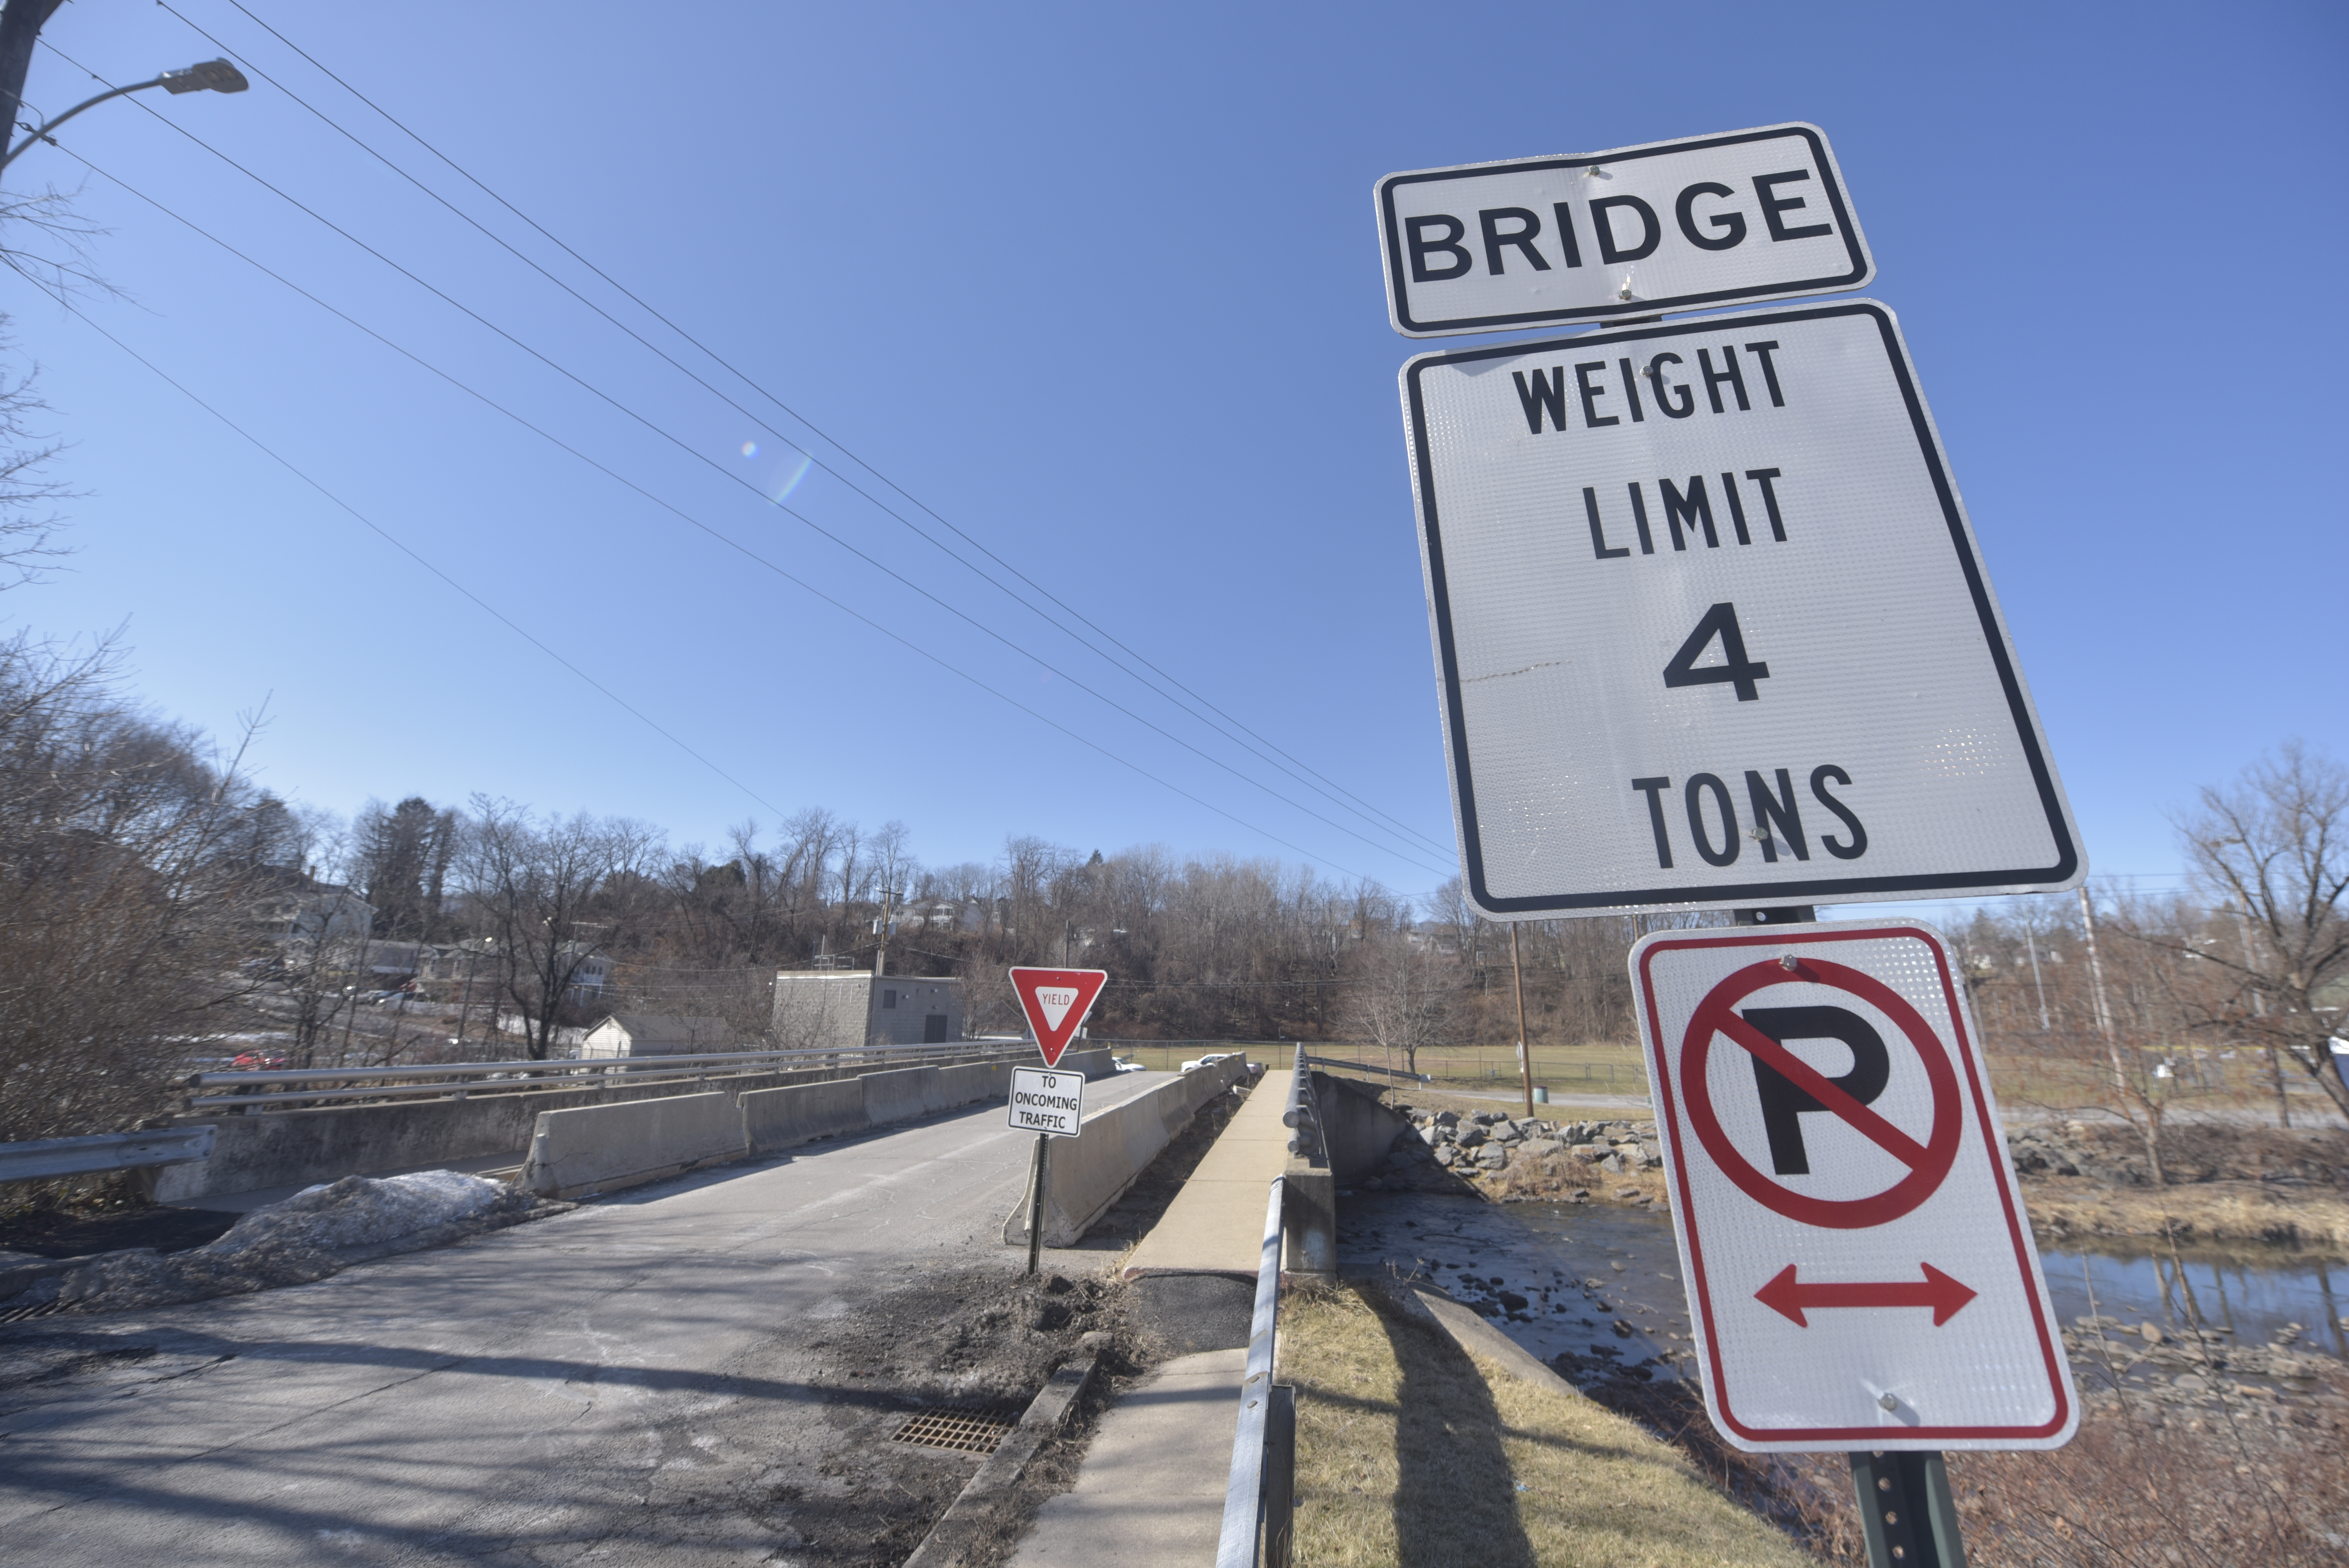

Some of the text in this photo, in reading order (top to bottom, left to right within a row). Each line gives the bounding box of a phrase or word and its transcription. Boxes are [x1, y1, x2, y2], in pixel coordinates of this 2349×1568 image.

[1404, 169, 1833, 283] BRIDGE
[1512, 340, 1785, 435] WEIGHT
[1583, 468, 1788, 559] LIMIT
[1663, 602, 1770, 702] 4
[1632, 764, 1868, 869] TONS
[1043, 994, 1069, 1005] YIELD
[1015, 1092, 1077, 1111] ONCOMING
[1019, 1111, 1066, 1129] TRAFFIC
[1042, 1075, 1056, 1089] TO
